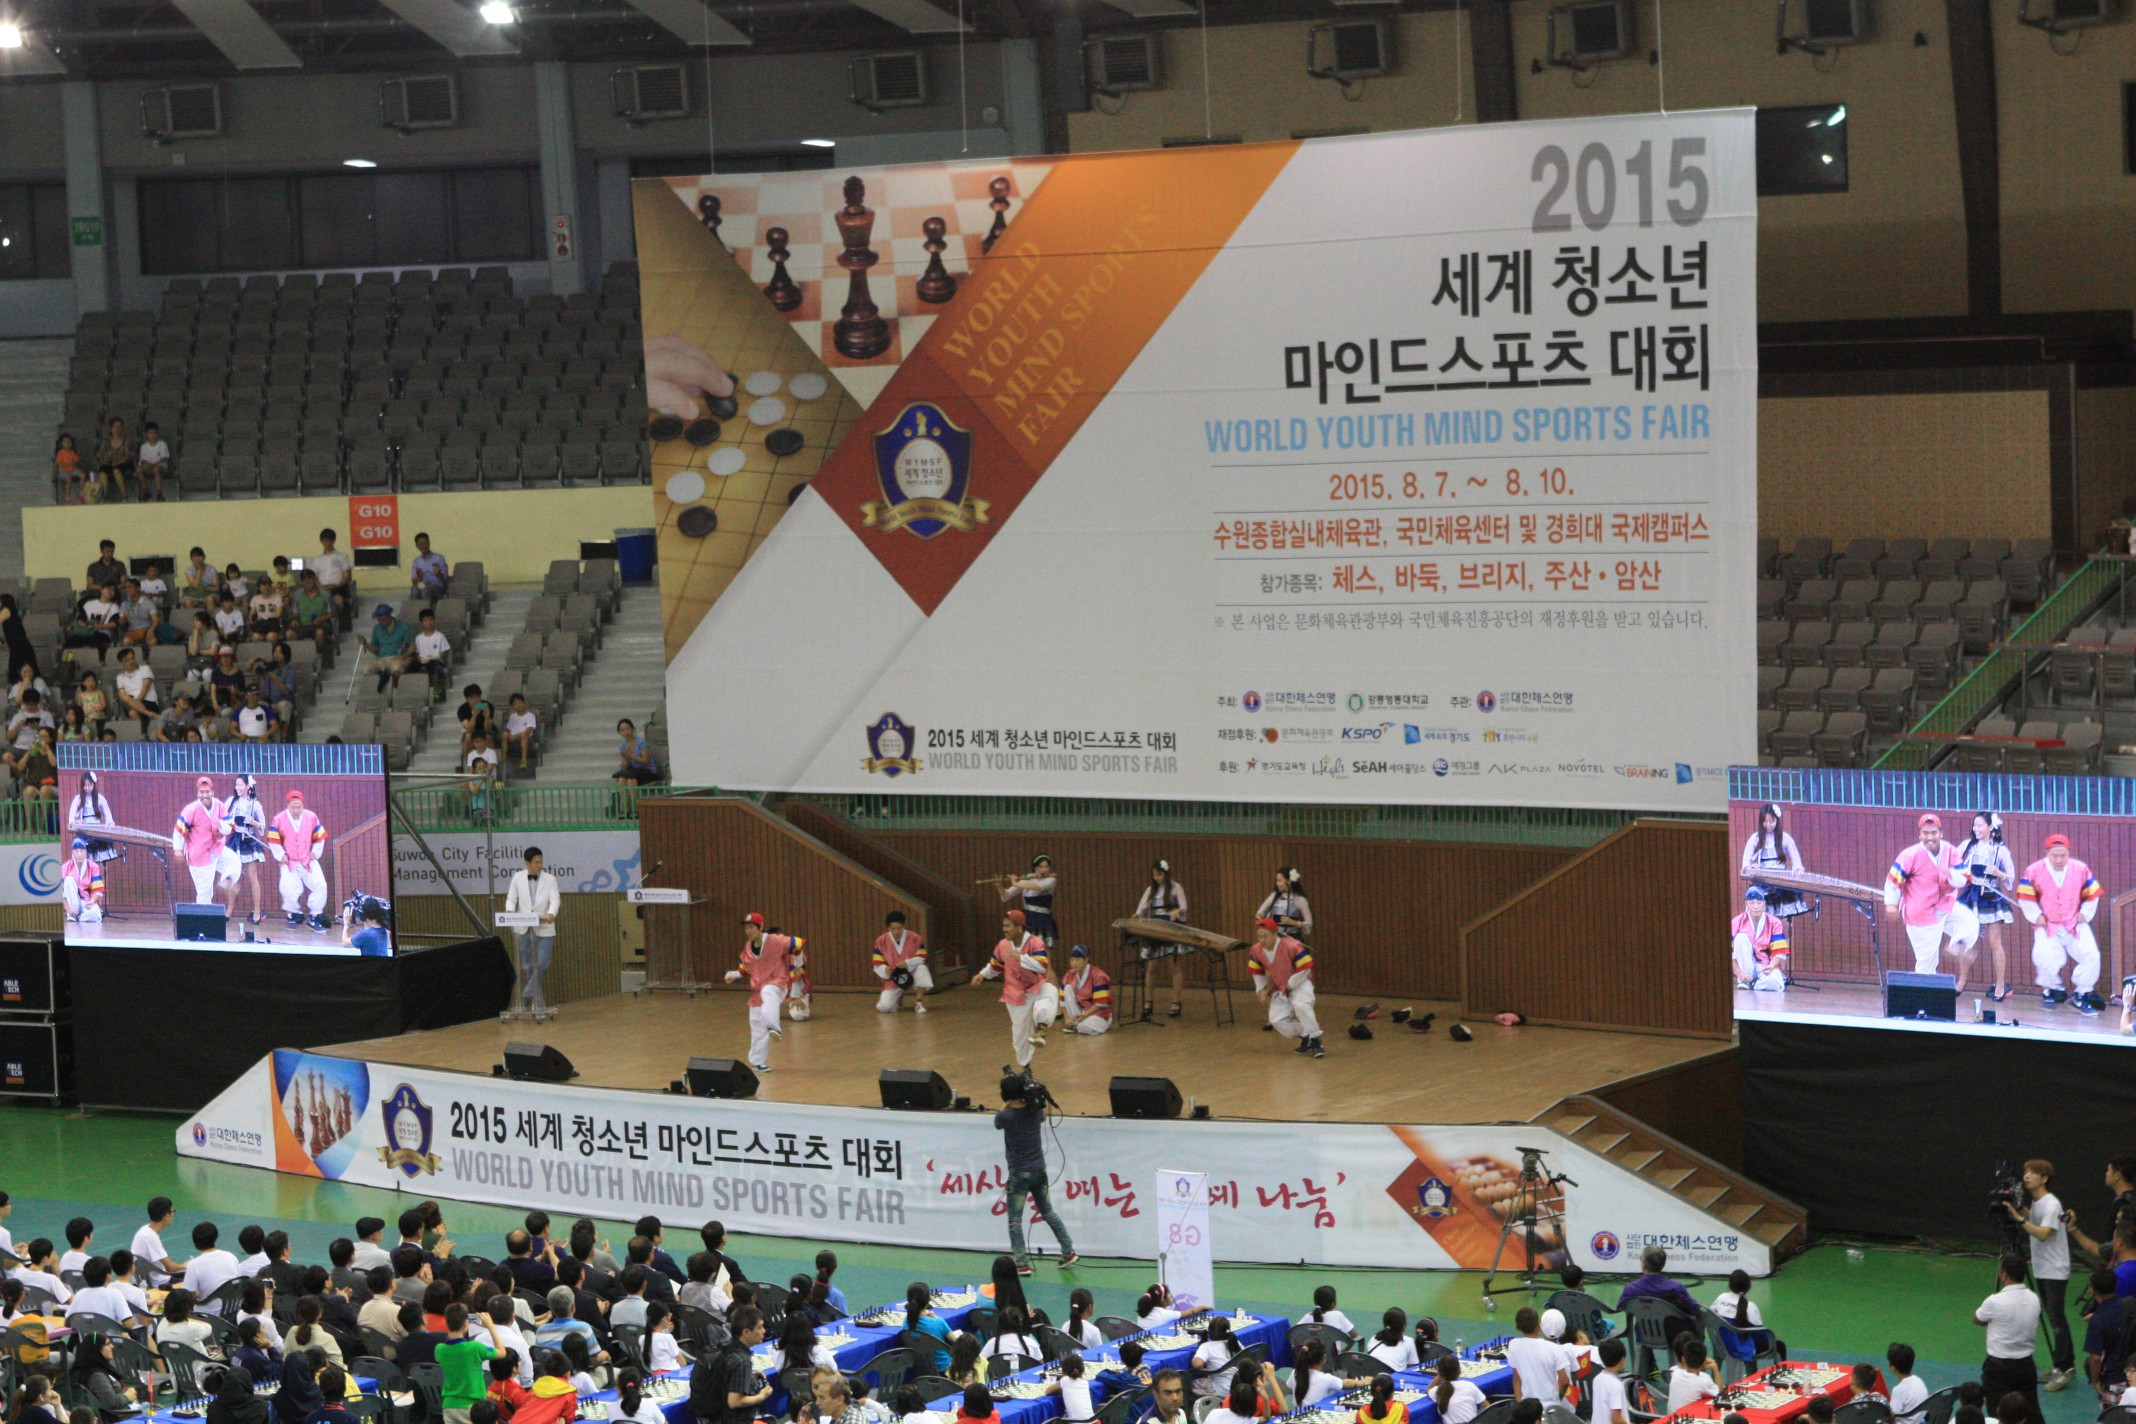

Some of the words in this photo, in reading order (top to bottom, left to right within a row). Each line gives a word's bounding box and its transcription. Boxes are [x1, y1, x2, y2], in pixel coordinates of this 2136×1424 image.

[1530, 137, 1710, 234] 2015
[1431, 248, 1534, 317] 세계
[1551, 240, 1709, 317] 청소년
[944, 241, 1041, 359] WORLD
[967, 273, 1063, 387] YOUTH
[993, 328, 1066, 419] MIND
[1284, 329, 1592, 405] 마인드스포츠
[1609, 323, 1710, 392] 대회
[1017, 366, 1085, 446] FAIR
[1205, 417, 1308, 454] WORLD
[1317, 413, 1414, 450] YOUTH
[1424, 410, 1501, 446] MIND
[1512, 406, 1632, 443] SPORTS
[1642, 404, 1710, 441] FAIR
[1329, 473, 1393, 500] 2015.
[1539, 467, 1574, 496] 10.
[359, 504, 392, 518] G10
[360, 526, 393, 539] G10
[1213, 518, 1388, 551] 수원종합실내체육관,
[1396, 514, 1510, 546] 국민체육센터
[1519, 513, 1537, 543] 및
[1546, 513, 1603, 544] 경희대
[1611, 512, 1709, 543] 국제캠퍼스
[1332, 565, 1384, 595] 체스,
[1395, 563, 1447, 594] 바둑,
[1458, 561, 1534, 593] 브리지,
[1231, 613, 1245, 631] 본
[1249, 612, 1290, 631] 사업은
[1295, 611, 1403, 631] 문화체육관광부와
[1408, 610, 1533, 630] 국민체육진흥공단의
[1539, 610, 1609, 629] 재정후원을
[1614, 610, 1642, 629] 받고
[1648, 610, 1708, 630] 있습니다.
[928, 729, 965, 748] 2015
[970, 729, 999, 749] 세계
[1004, 729, 1048, 750] 청소년
[1053, 730, 1142, 750] 마인드스포츠
[1147, 731, 1176, 752] 대회
[1341, 727, 1383, 739] KSPO
[928, 752, 981, 769] WORLD
[984, 753, 1035, 770] YOUTH
[1040, 753, 1078, 771] MIND
[1082, 754, 1141, 772] SPORTS
[1144, 755, 1178, 774] FAIR
[1558, 764, 1605, 774] NOVOTEL
[393, 849, 434, 861] Suwo
[442, 847, 469, 863] City
[450, 1101, 506, 1143] 2015
[515, 1110, 563, 1151] 세계
[571, 1115, 648, 1161] 청소년
[658, 1123, 832, 1171] 마인드스포츠
[843, 1138, 903, 1180] 대회
[451, 1147, 534, 1192] WORLD
[540, 1157, 624, 1201] YOUTH
[632, 1168, 703, 1209] MIND
[712, 1176, 828, 1220] SPORTS
[837, 1185, 906, 1225] FAIR
[1643, 1234, 1739, 1252] 대한체스연맹
[1688, 1252, 1739, 1262] Federation
